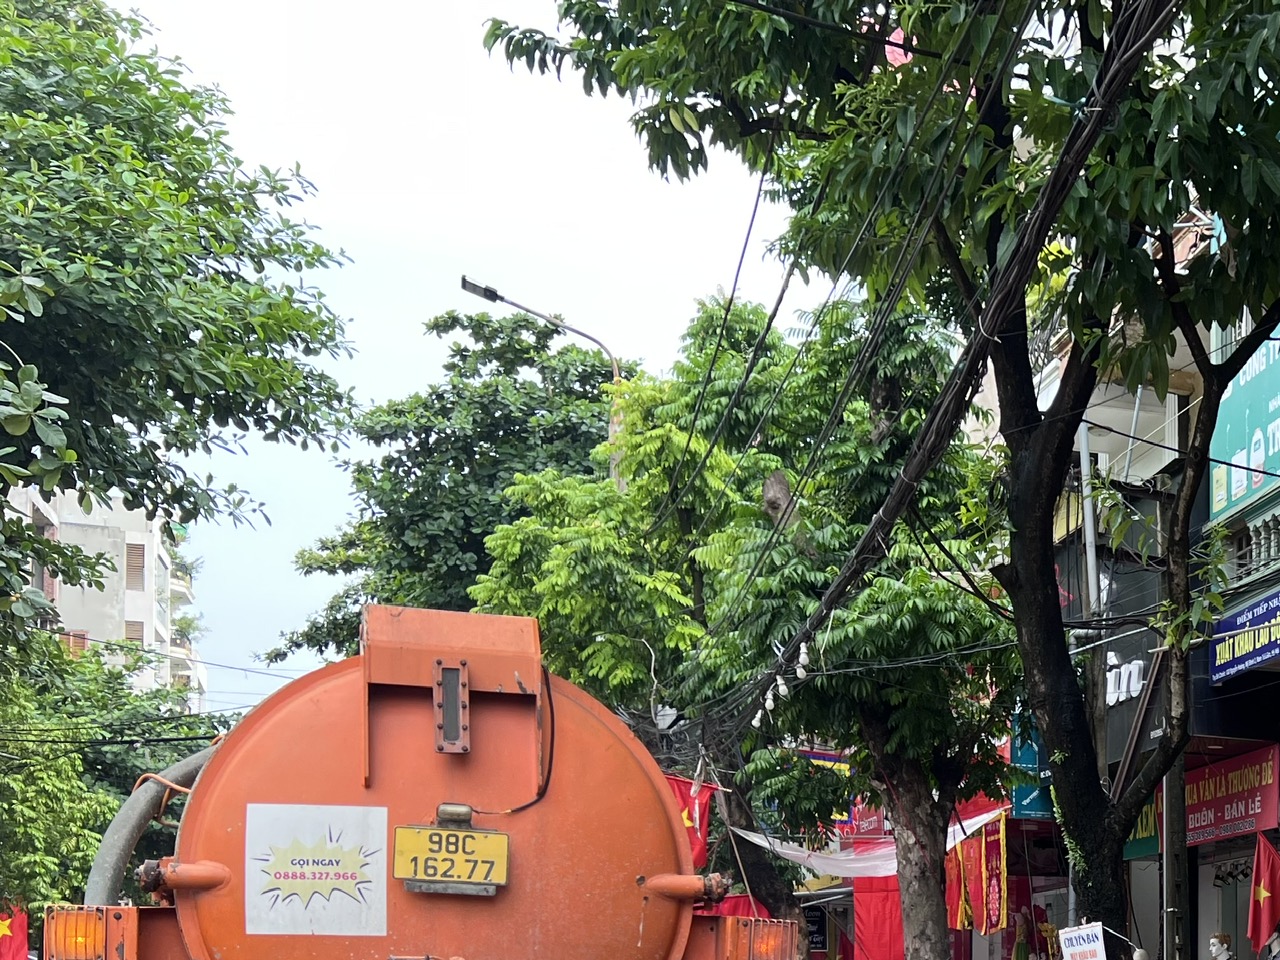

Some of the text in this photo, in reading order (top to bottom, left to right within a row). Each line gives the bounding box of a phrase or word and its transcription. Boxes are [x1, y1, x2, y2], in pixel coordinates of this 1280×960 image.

[1188, 807, 1215, 829] BUÔN
[1224, 800, 1245, 821] BÁN
[1248, 792, 1262, 815] LẺ
[428, 832, 476, 856] 98C
[290, 858, 341, 869] GỌI NGAY
[410, 856, 496, 882] 162.77
[274, 871, 357, 881] 0888.327.966
